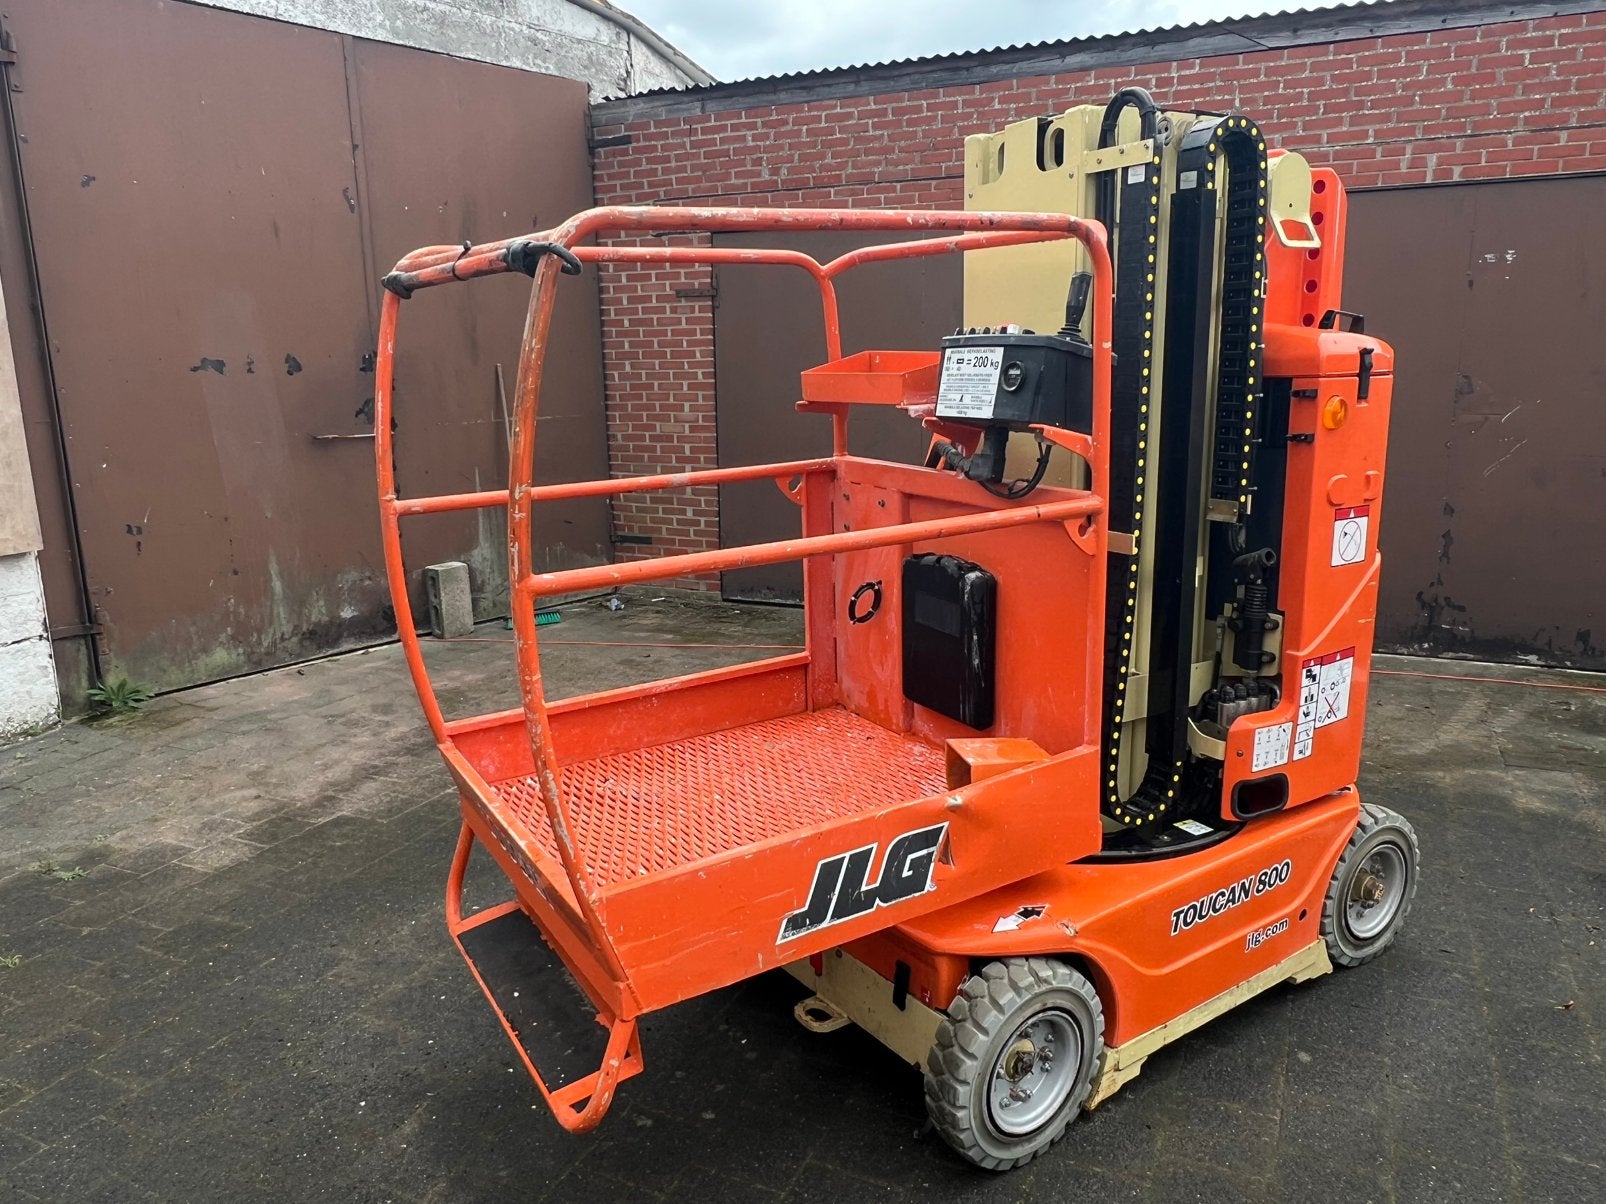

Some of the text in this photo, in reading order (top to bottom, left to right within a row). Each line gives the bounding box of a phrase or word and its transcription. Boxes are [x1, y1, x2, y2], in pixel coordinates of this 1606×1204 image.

[973, 356, 989, 368] 200
[990, 359, 1000, 371] kg
[776, 821, 950, 945] JLG
[1171, 859, 1291, 936] TOUCAN 800
[1245, 918, 1289, 953] jlg.com
